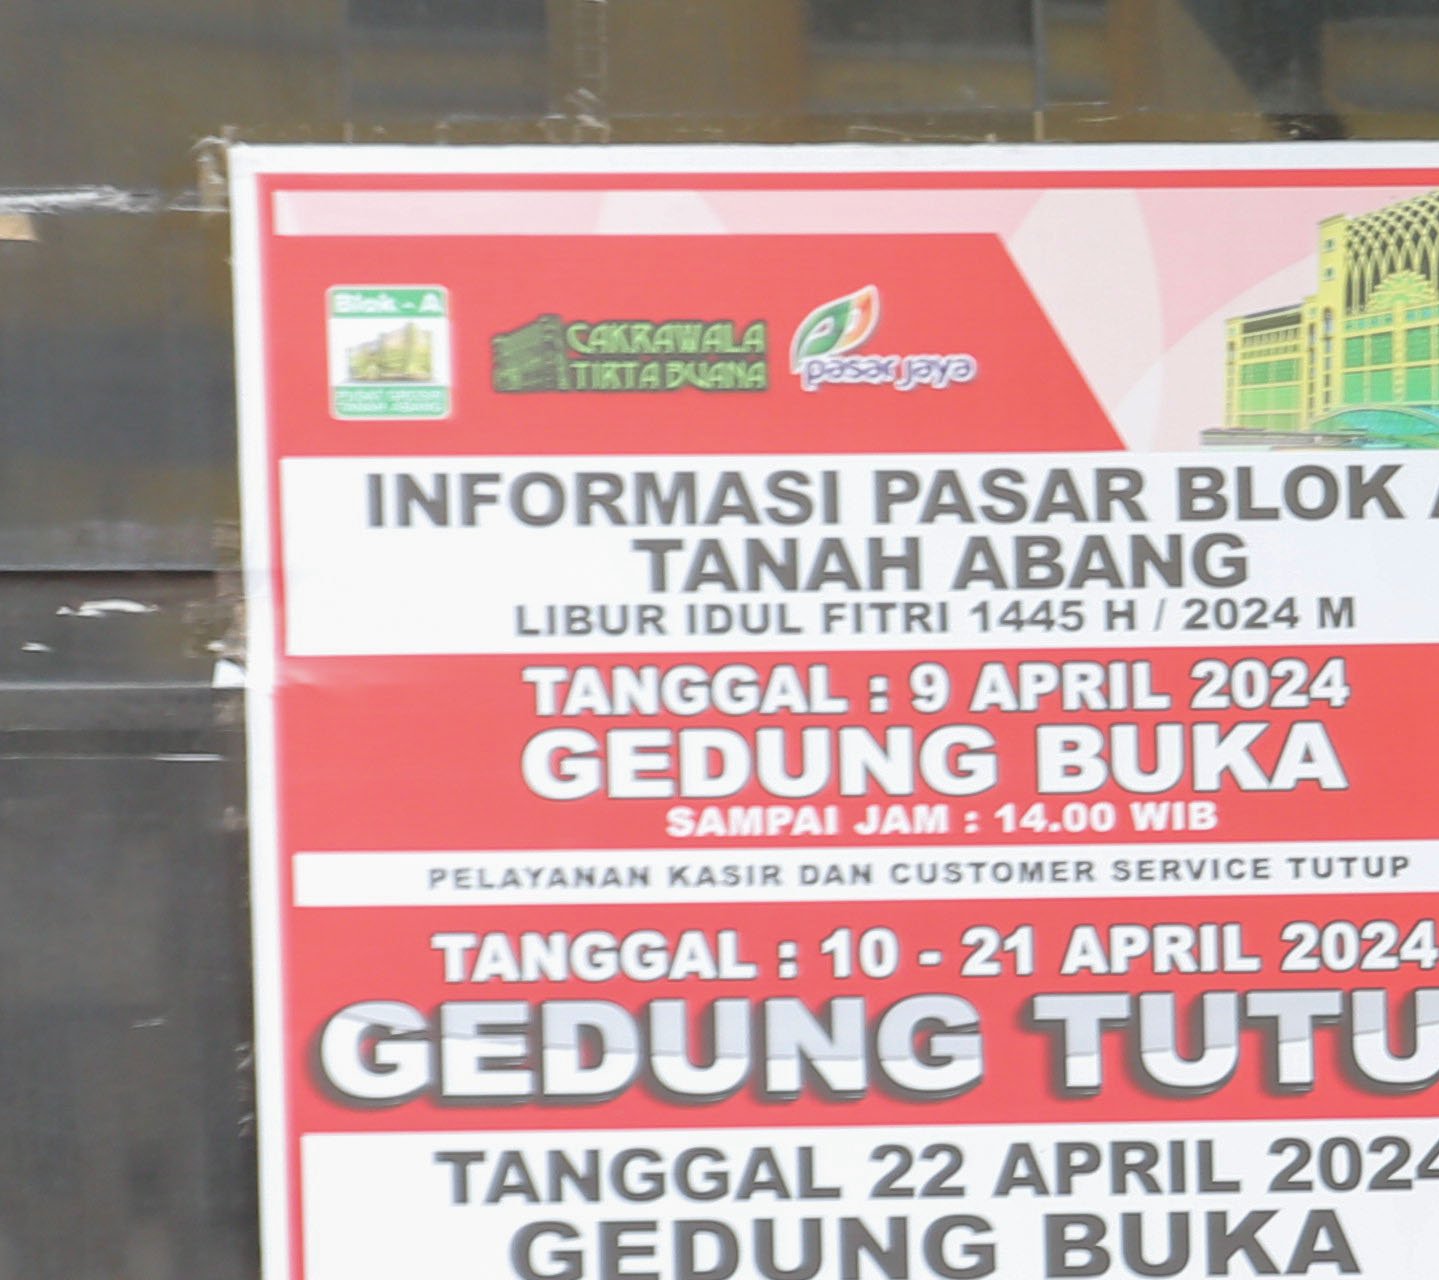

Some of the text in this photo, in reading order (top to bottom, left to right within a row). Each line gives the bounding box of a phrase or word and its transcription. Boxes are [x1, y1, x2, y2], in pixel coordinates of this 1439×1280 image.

[419, 291, 445, 313] A
[565, 320, 767, 354] CAKRAWALA
[569, 357, 767, 392] TIRTA BUANA
[801, 355, 977, 388] pasar jaya
[368, 469, 840, 528] INFORMASI
[874, 467, 1149, 525] PASAR
[1177, 463, 1405, 522] BLOK
[633, 532, 1248, 593] TANAH ABANG
[516, 596, 1355, 637] LIBUR IDUL FITRI 1445 H / 2024 M
[522, 658, 1350, 716] TANGGAL : 9 APRIL 2024
[522, 722, 1349, 800] GEDUNG BUKA
[666, 800, 1218, 838] SAMPAI JAM : 14.00 WIB
[429, 855, 1410, 890] PELAYANAN KASIR DAN CUSTOMER SERVICE TUTUP
[431, 920, 1439, 982] TANGGAL : 10 - 21 APRIL 2024
[321, 995, 983, 1099] GEDUNG
[435, 1145, 842, 1205] TANGGAL
[871, 1142, 966, 1199] 22
[994, 1139, 1241, 1197] APRIL
[1044, 1208, 1362, 1279] BUKA
